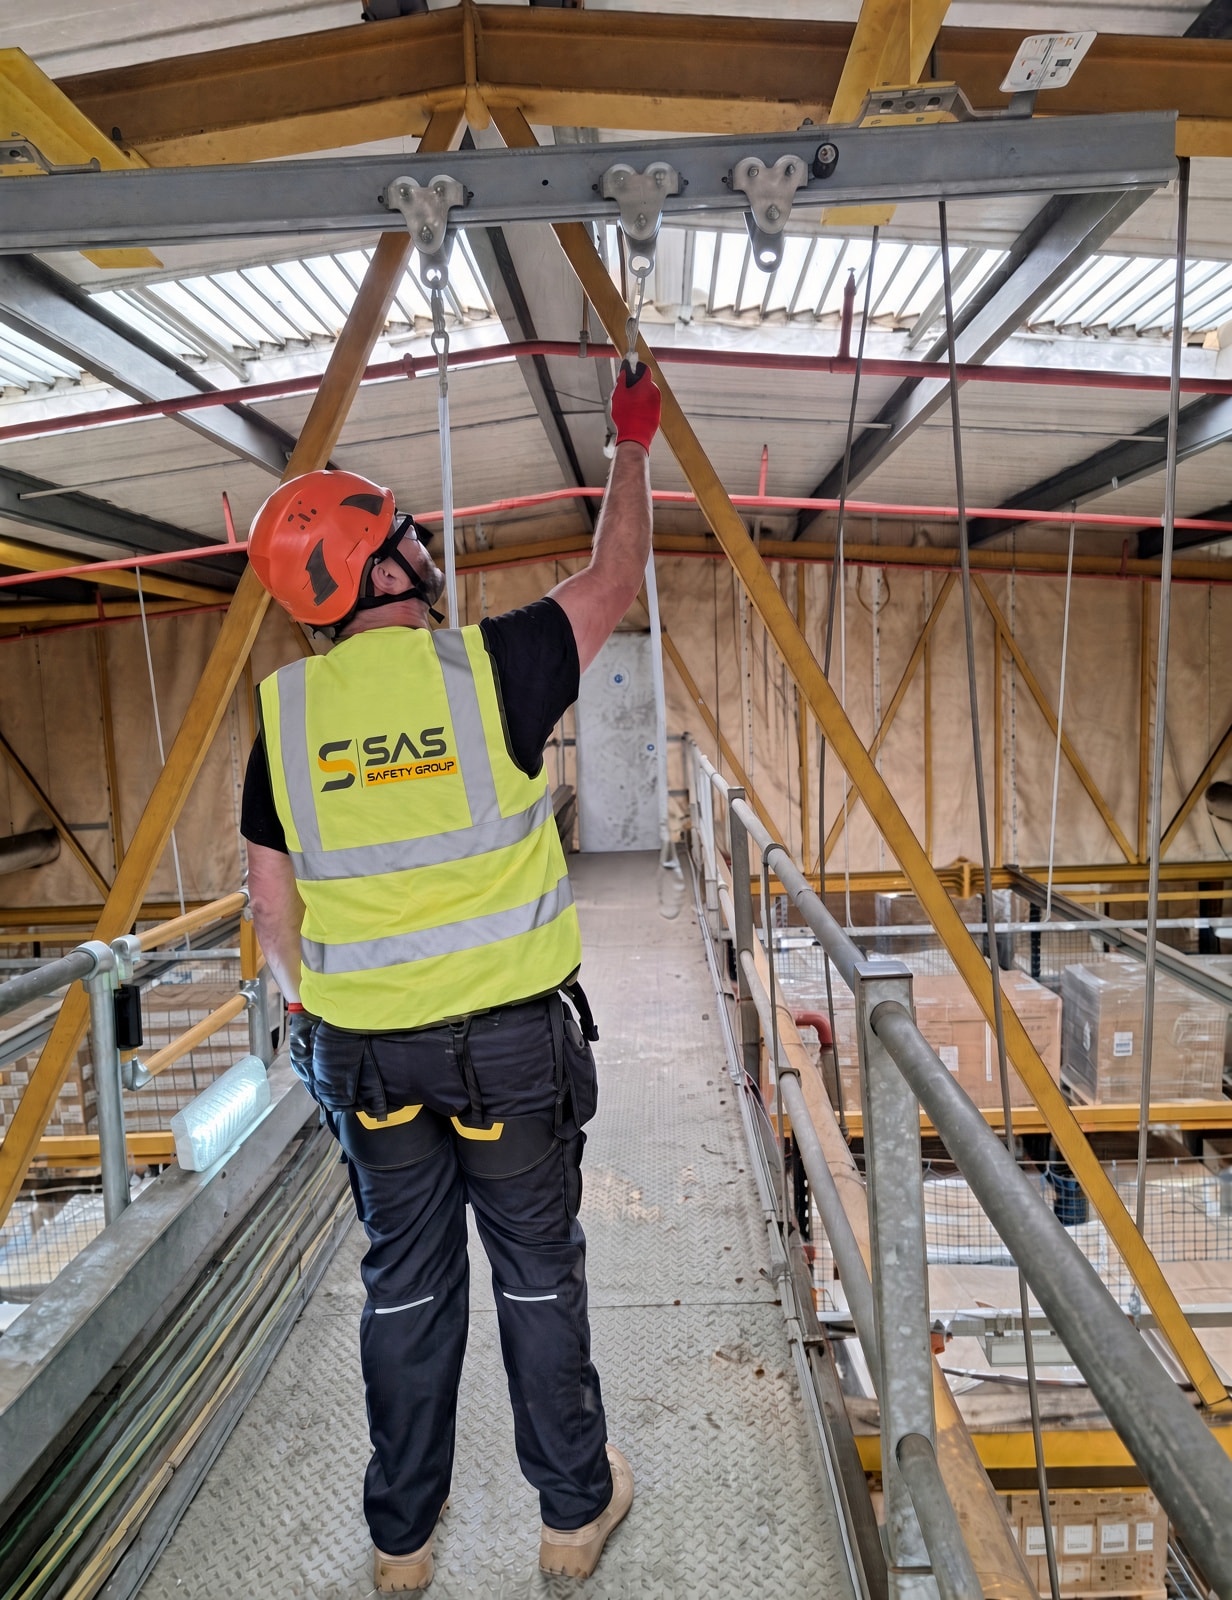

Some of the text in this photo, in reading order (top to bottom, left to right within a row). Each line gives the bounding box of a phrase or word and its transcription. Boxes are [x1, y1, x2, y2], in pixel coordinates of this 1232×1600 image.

[362, 726, 447, 767] SAS
[367, 761, 455, 782] SAFETY GROUP
